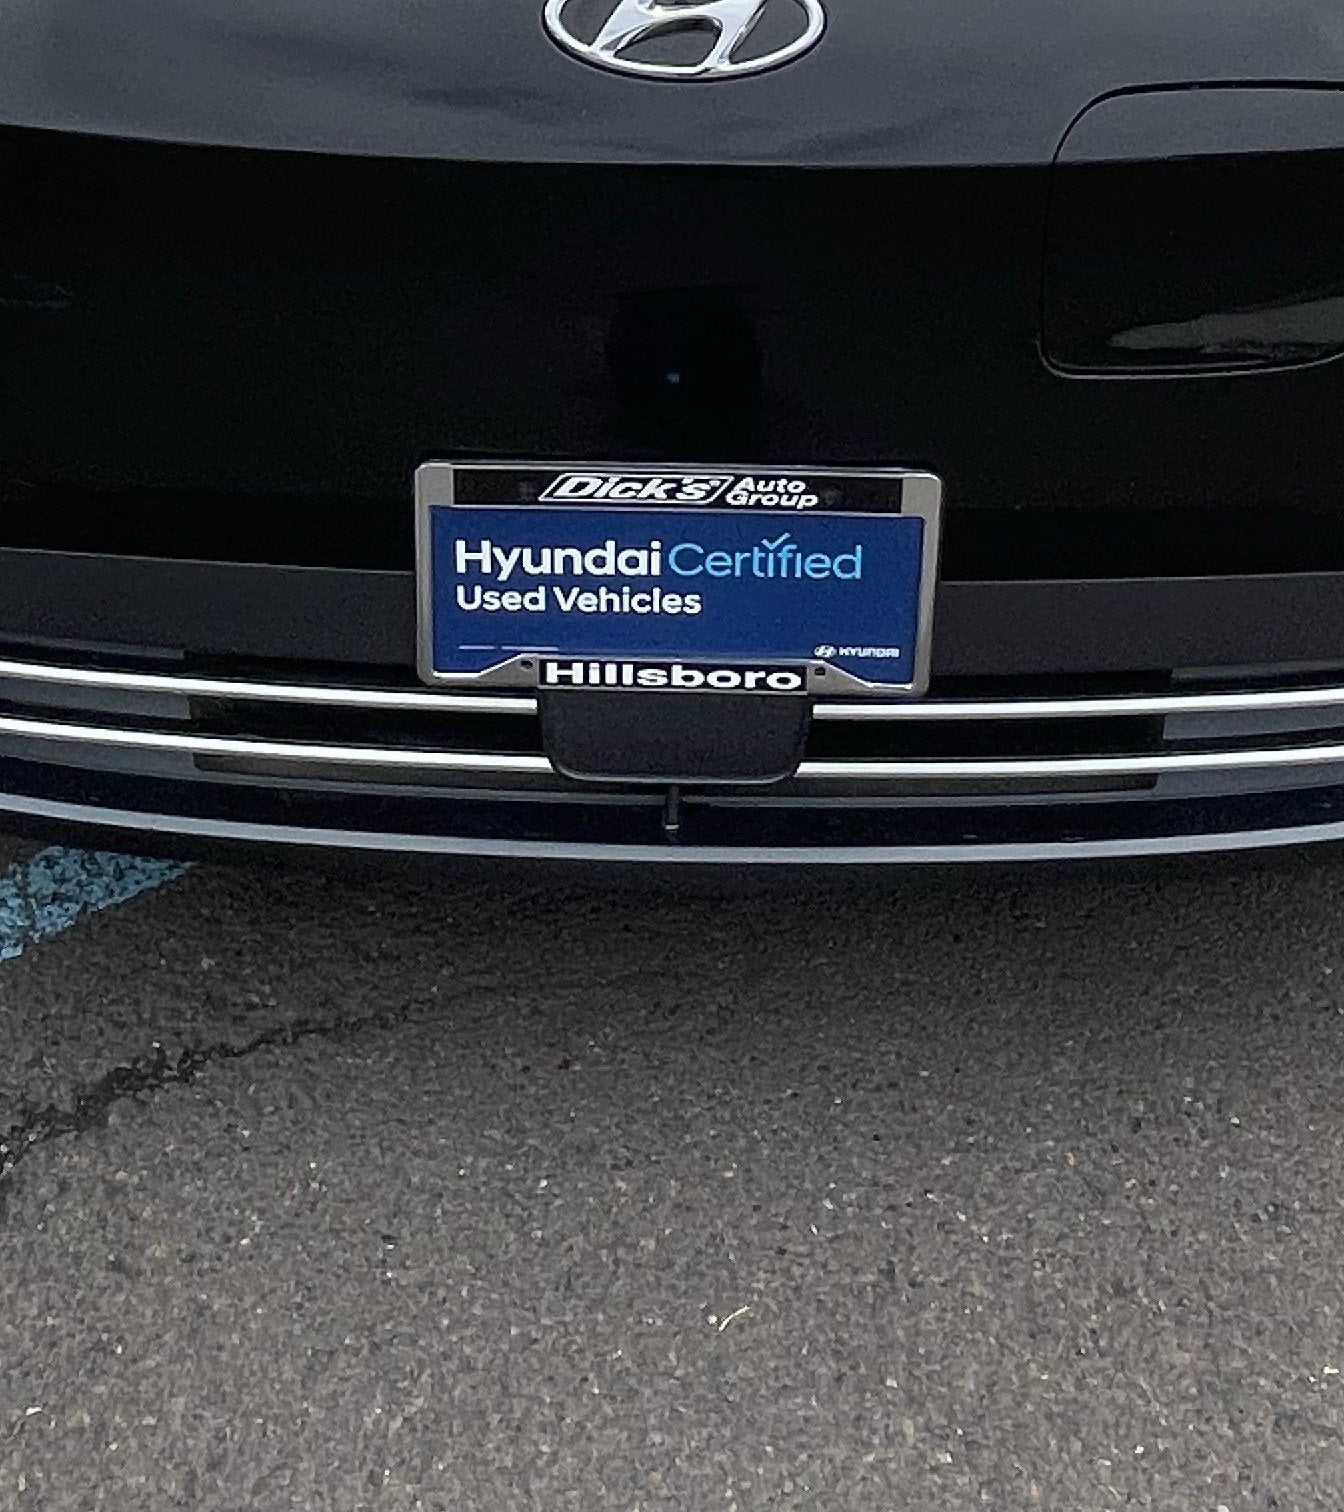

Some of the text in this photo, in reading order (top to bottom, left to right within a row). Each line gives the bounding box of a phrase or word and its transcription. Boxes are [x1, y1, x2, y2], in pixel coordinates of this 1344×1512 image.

[552, 476, 713, 501] Dick's
[732, 476, 806, 494] Auto
[725, 490, 819, 509] Group
[456, 533, 863, 581] Hyundai Certified
[456, 585, 702, 615] Used Vehicles
[838, 647, 900, 658] HYUNDAI
[544, 662, 803, 690] Hillsboro
